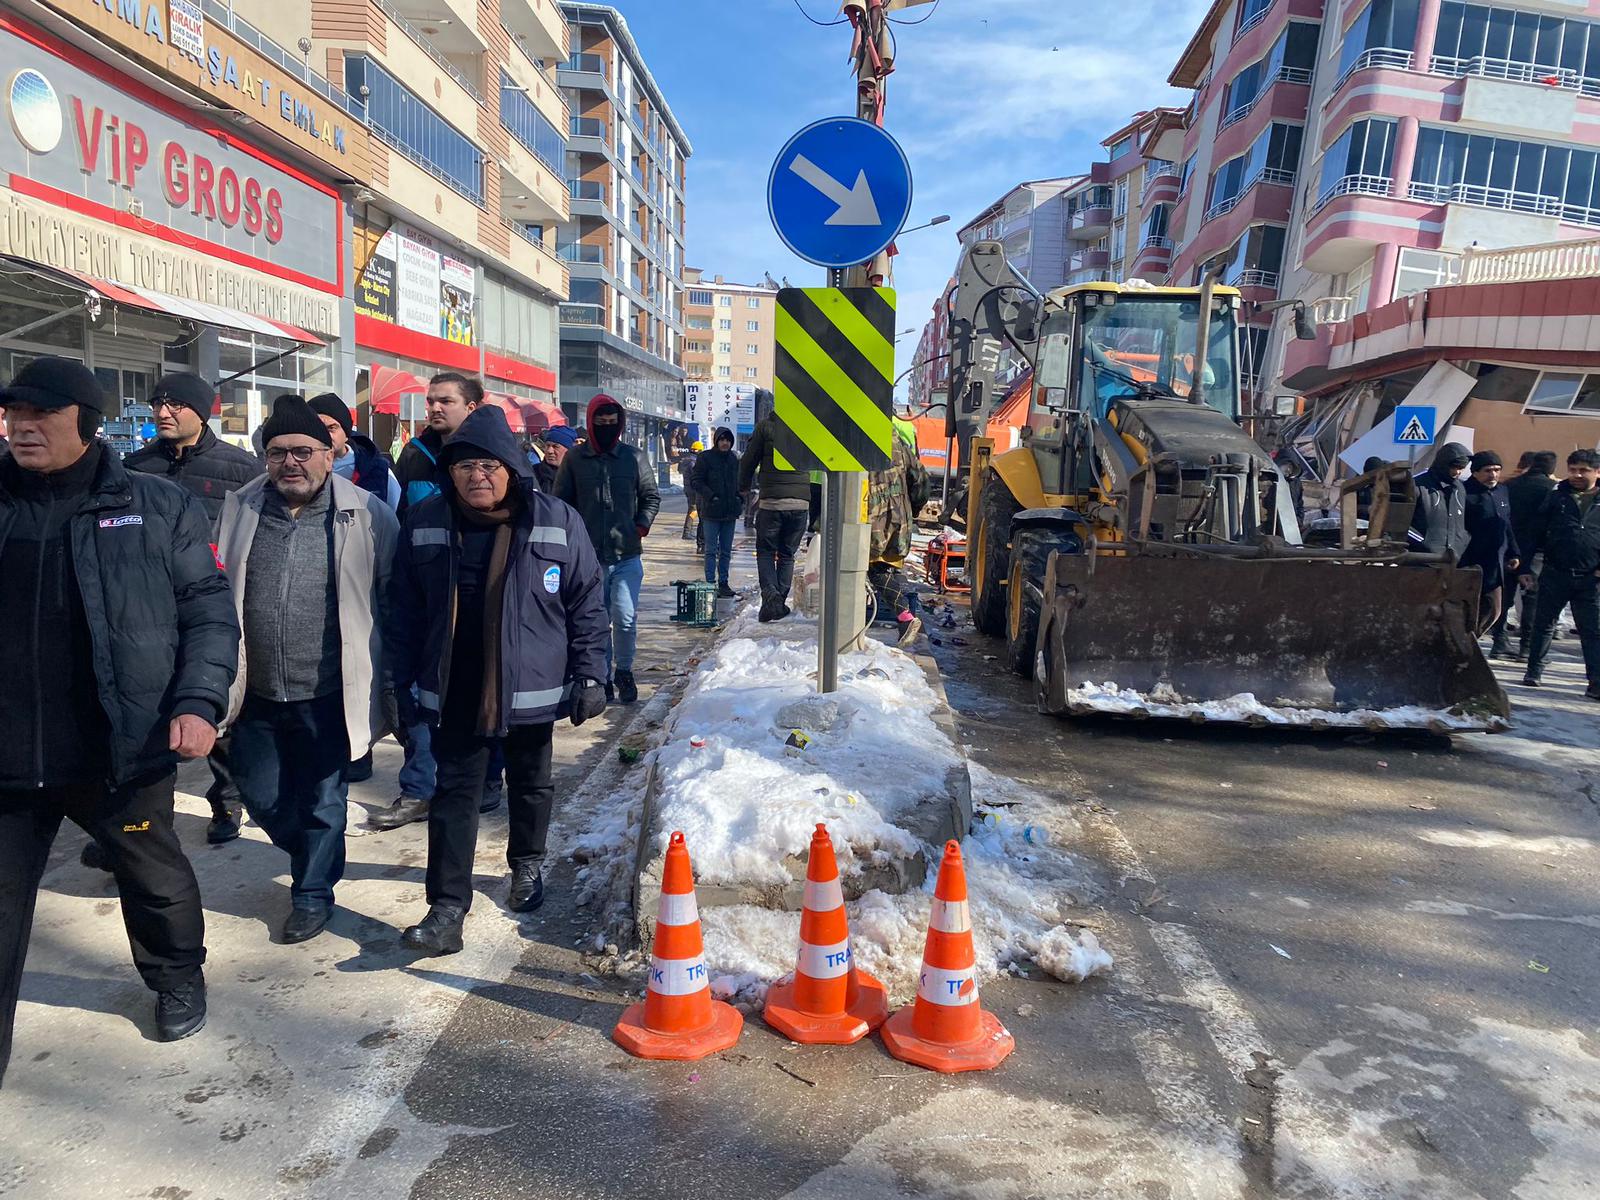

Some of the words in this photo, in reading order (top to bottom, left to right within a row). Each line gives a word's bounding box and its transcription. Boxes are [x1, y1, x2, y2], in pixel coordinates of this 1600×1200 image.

[280, 90, 346, 155] EMLAK
[160, 140, 284, 246] GROSS
[194, 262, 214, 304] VE
[216, 268, 288, 324] PERAKENDE
